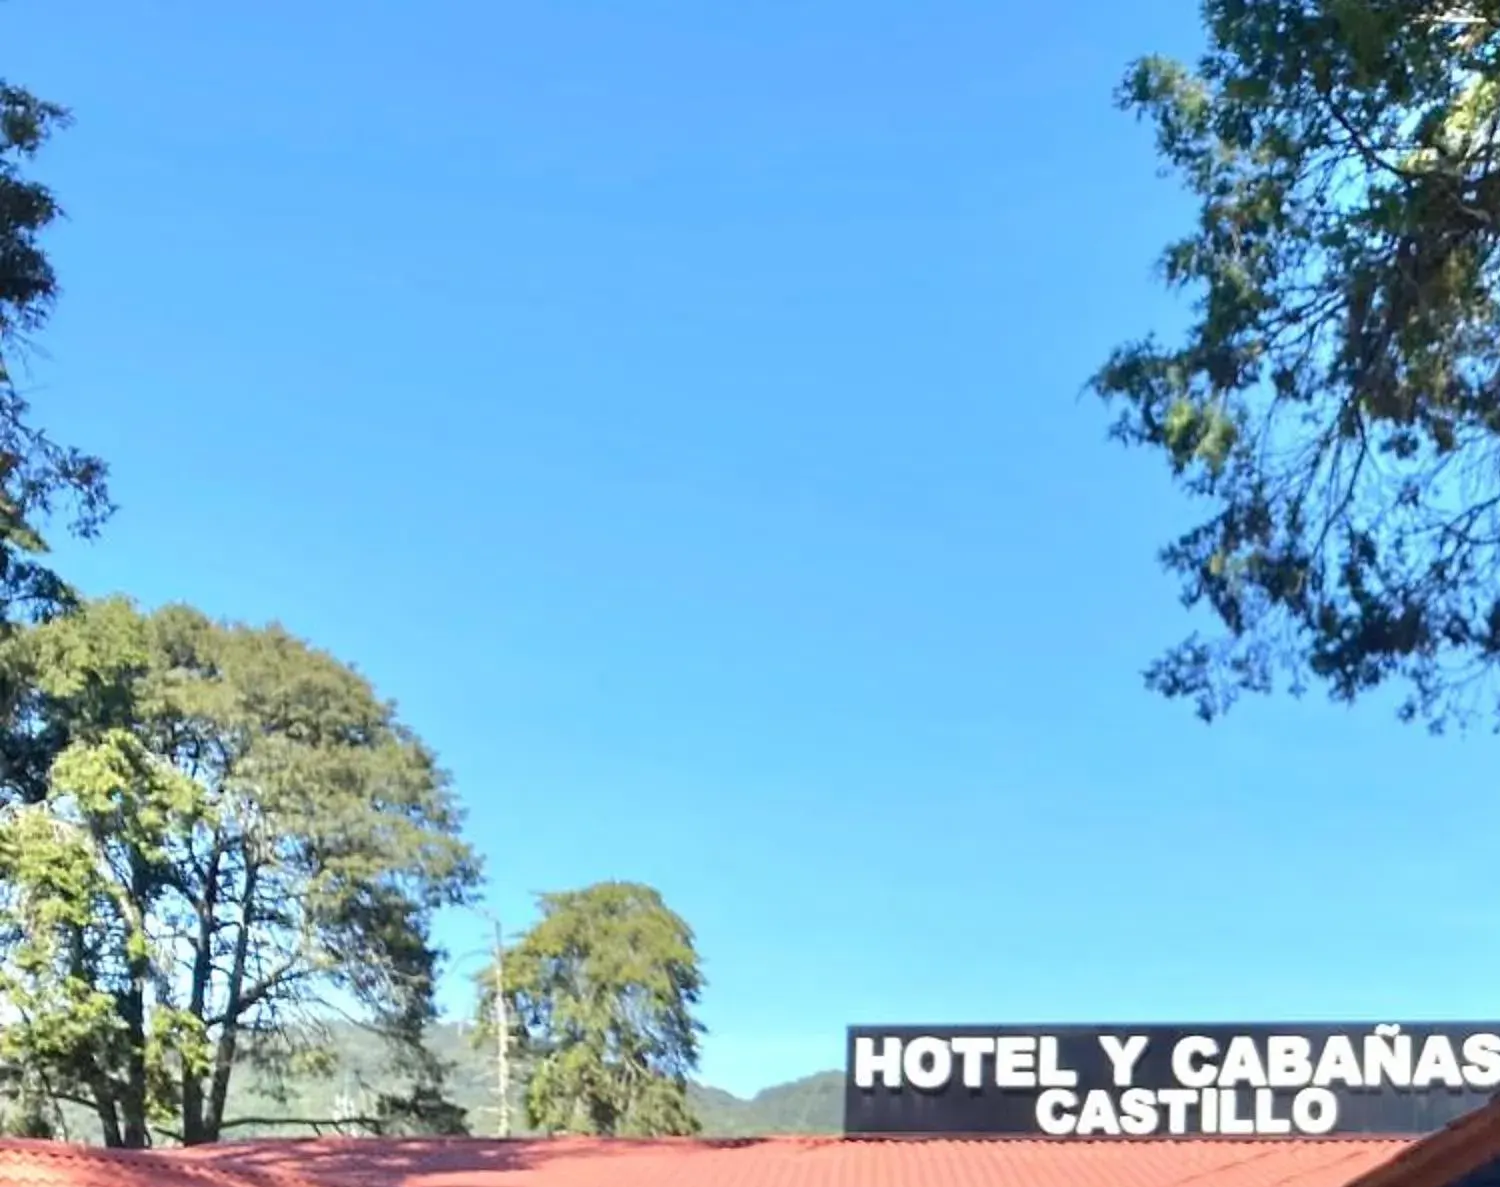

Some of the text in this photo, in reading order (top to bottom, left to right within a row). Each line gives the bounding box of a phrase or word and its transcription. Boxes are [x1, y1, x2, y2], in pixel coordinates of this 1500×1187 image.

[855, 1036, 1076, 1087] HOTEL
[1099, 1035, 1148, 1086] Y
[1035, 1088, 1338, 1135] CASTILLO
